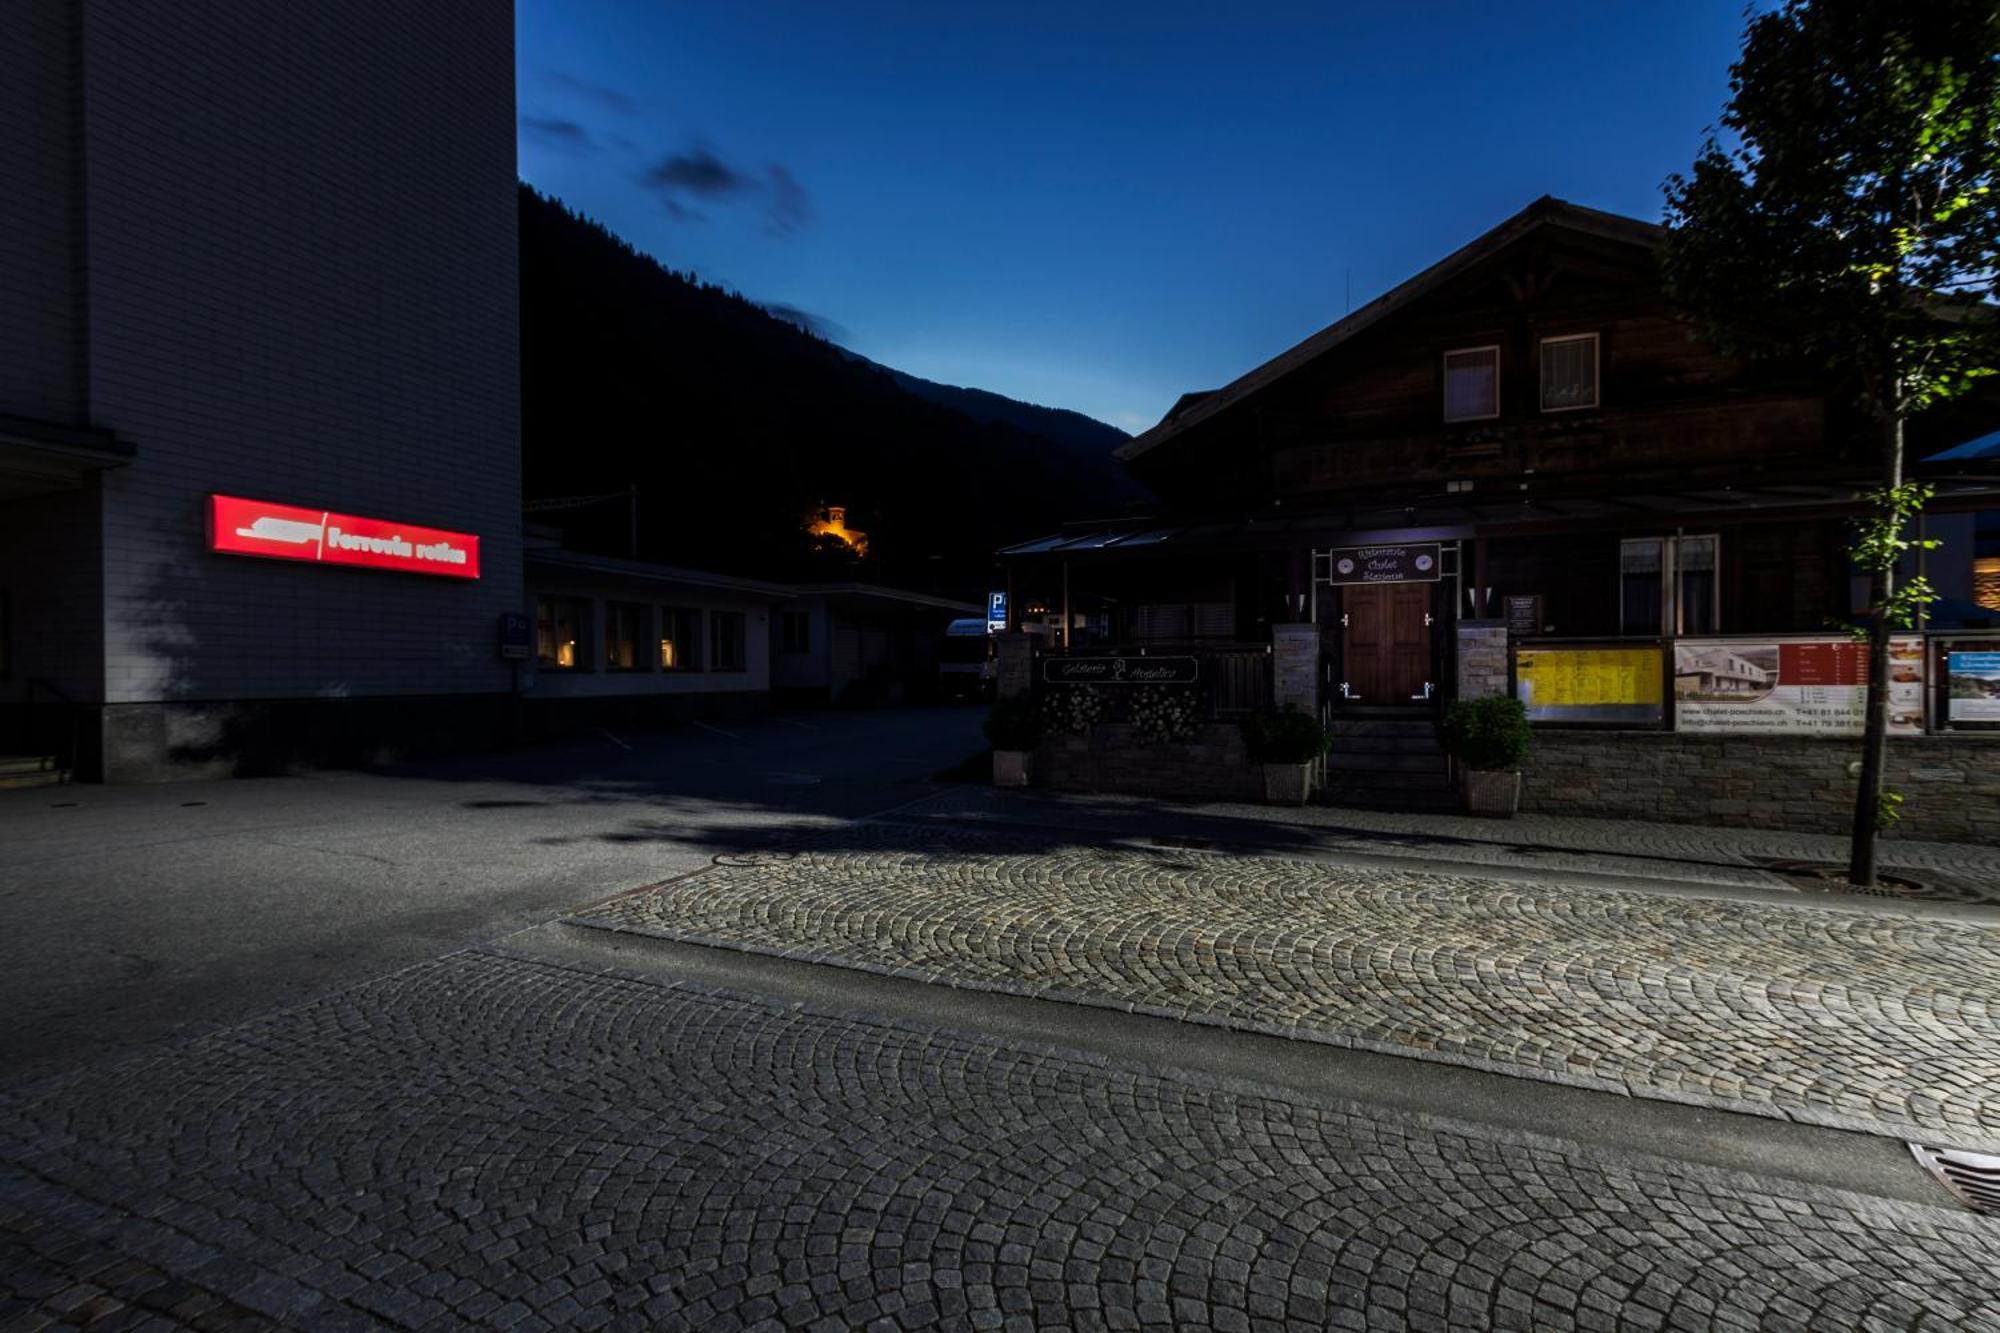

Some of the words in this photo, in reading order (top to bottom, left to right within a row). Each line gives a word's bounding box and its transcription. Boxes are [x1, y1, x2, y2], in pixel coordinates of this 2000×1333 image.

[327, 527, 412, 557] Ferrovia
[1367, 558, 1398, 570] Chalet
[992, 595, 1003, 609] P
[507, 617, 517, 633] P
